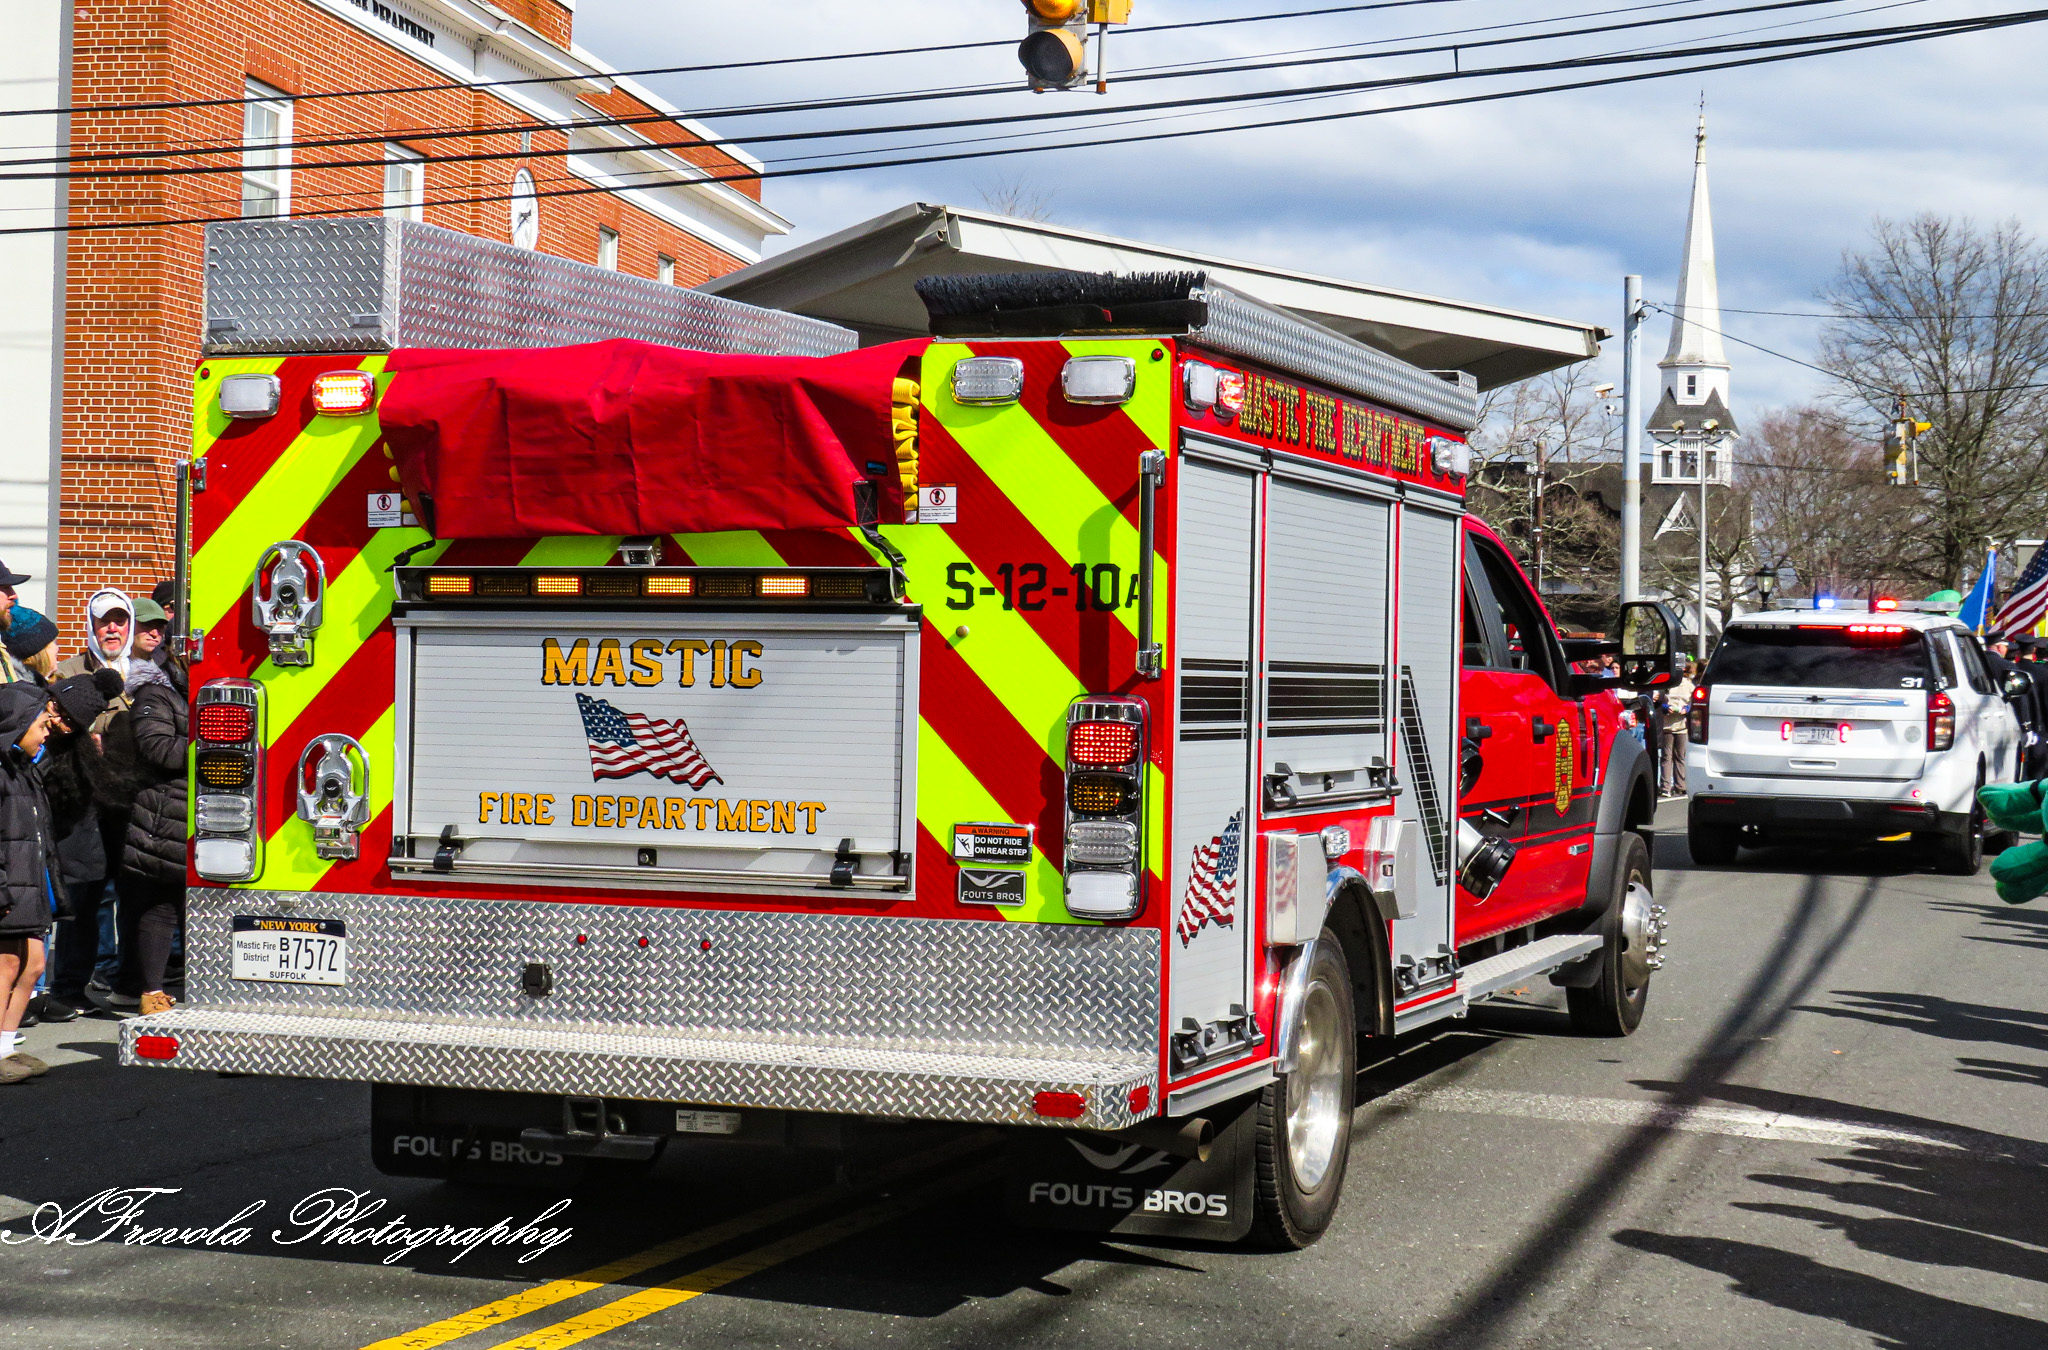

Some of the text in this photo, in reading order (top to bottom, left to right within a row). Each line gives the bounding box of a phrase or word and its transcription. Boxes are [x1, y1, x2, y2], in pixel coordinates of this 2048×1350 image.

[373, 0, 435, 48] DEPARTMENT
[1306, 391, 1338, 454] FIRE
[1342, 402, 1426, 478] DEPARTMENT
[541, 638, 764, 688] MASTIC
[1900, 676, 1925, 688] 31
[1764, 705, 1825, 716] MASTIC
[479, 792, 827, 834] FIRE DEPARTMENT
[975, 836, 1022, 846] DO NOT RIDE
[986, 847, 1008, 855] REAR
[1008, 848, 1028, 856] STEP
[962, 891, 1022, 901] FOUTS BROS
[260, 920, 319, 933] NEW YORK
[236, 940, 277, 951] Mastic Fire
[243, 952, 270, 962] District
[269, 970, 307, 980] SUFFOLK
[1029, 1182, 1228, 1217] FOUTS BROS
